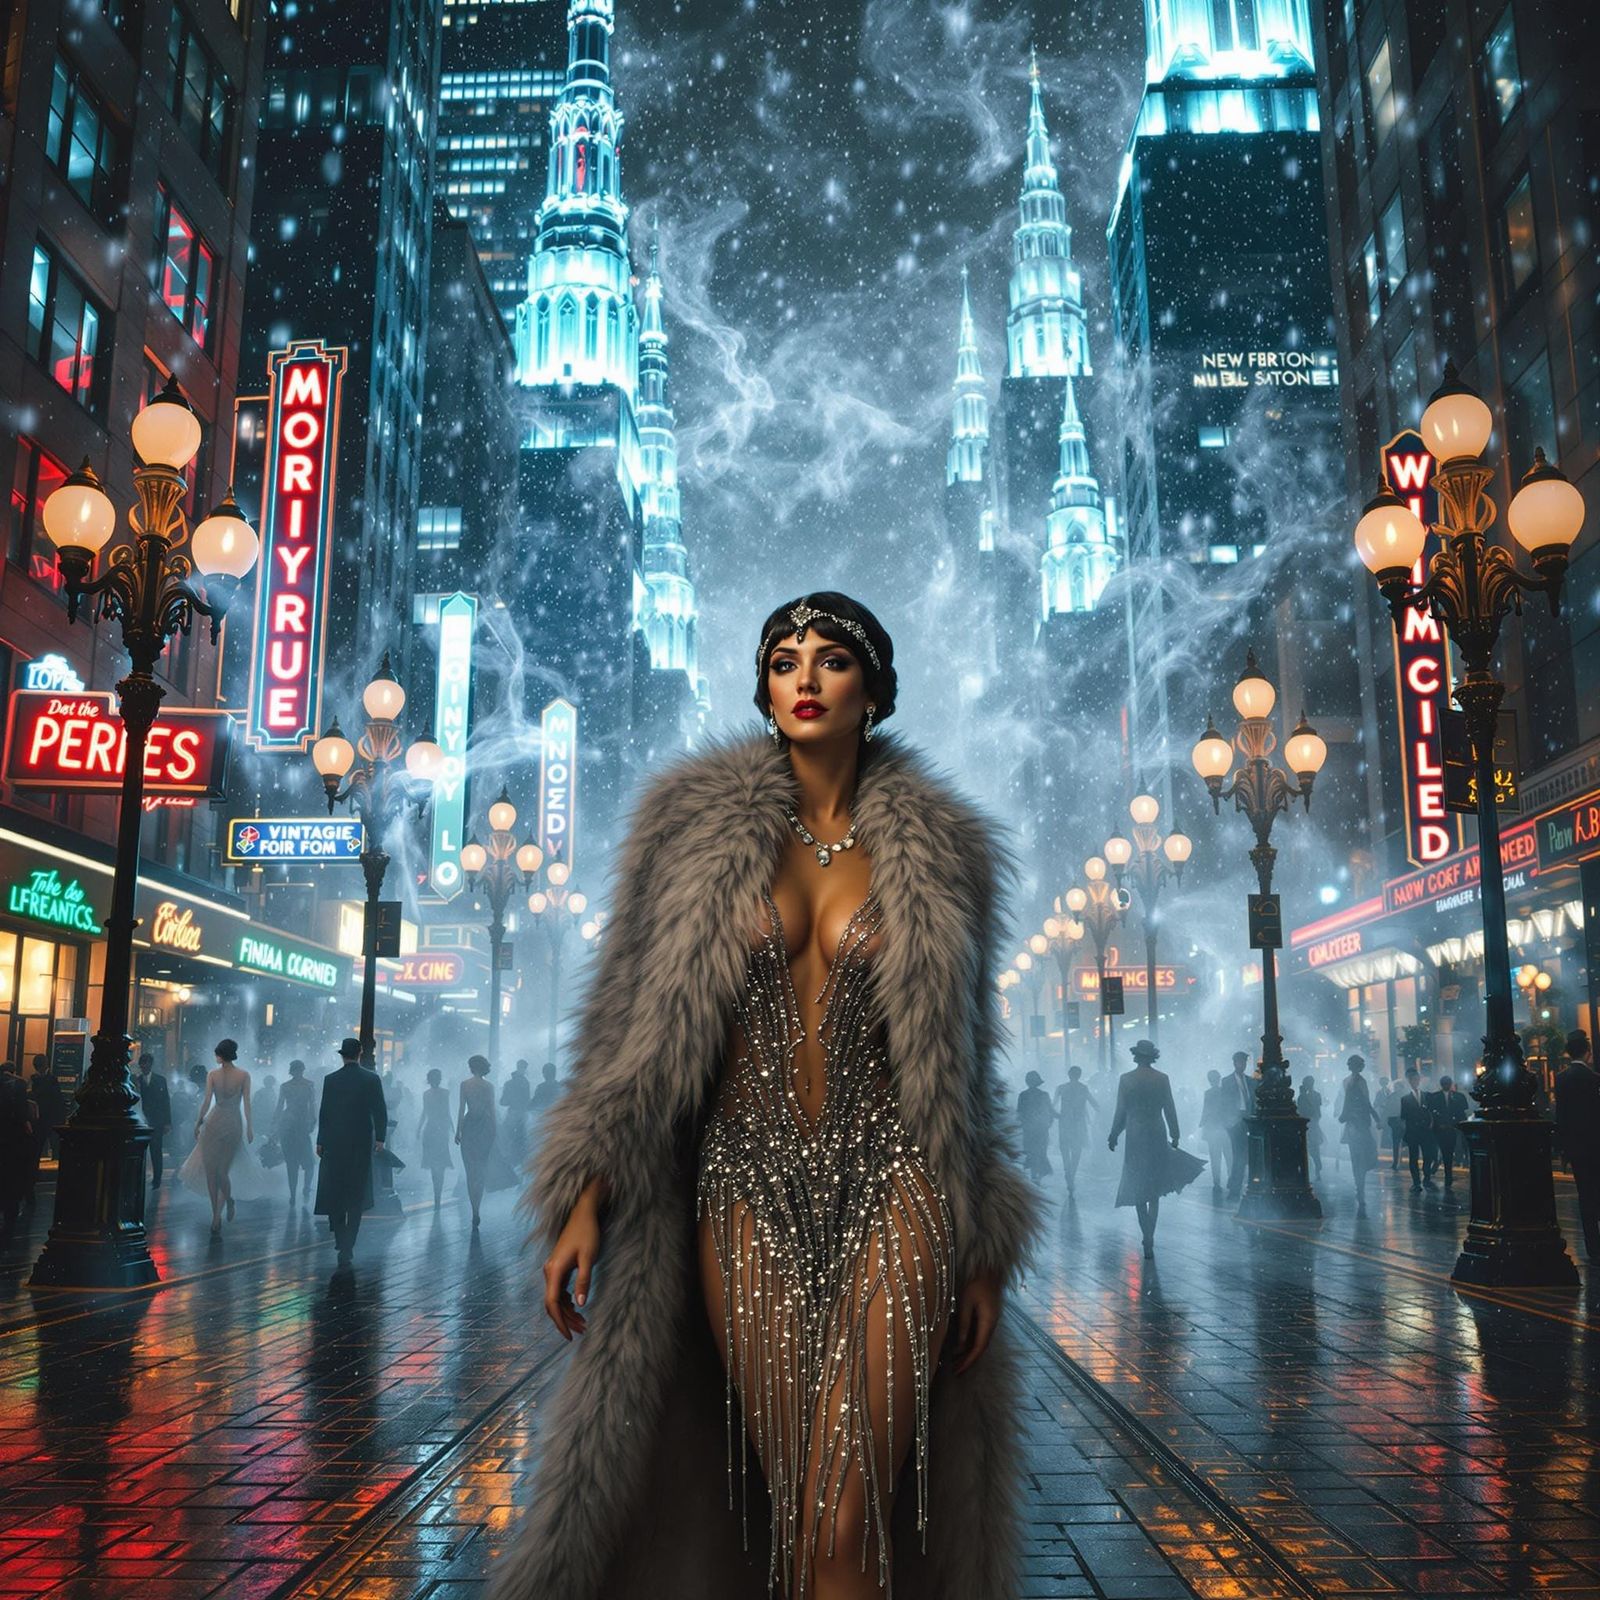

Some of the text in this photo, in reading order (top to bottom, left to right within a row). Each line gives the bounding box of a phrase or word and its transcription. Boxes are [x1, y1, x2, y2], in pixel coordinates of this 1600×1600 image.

[1202, 353, 1243, 368] NEW
[268, 367, 324, 728] MORIYRUE
[29, 716, 200, 780] PERES
[259, 839, 336, 855] FOIR FOM
[418, 962, 455, 980] CINE
